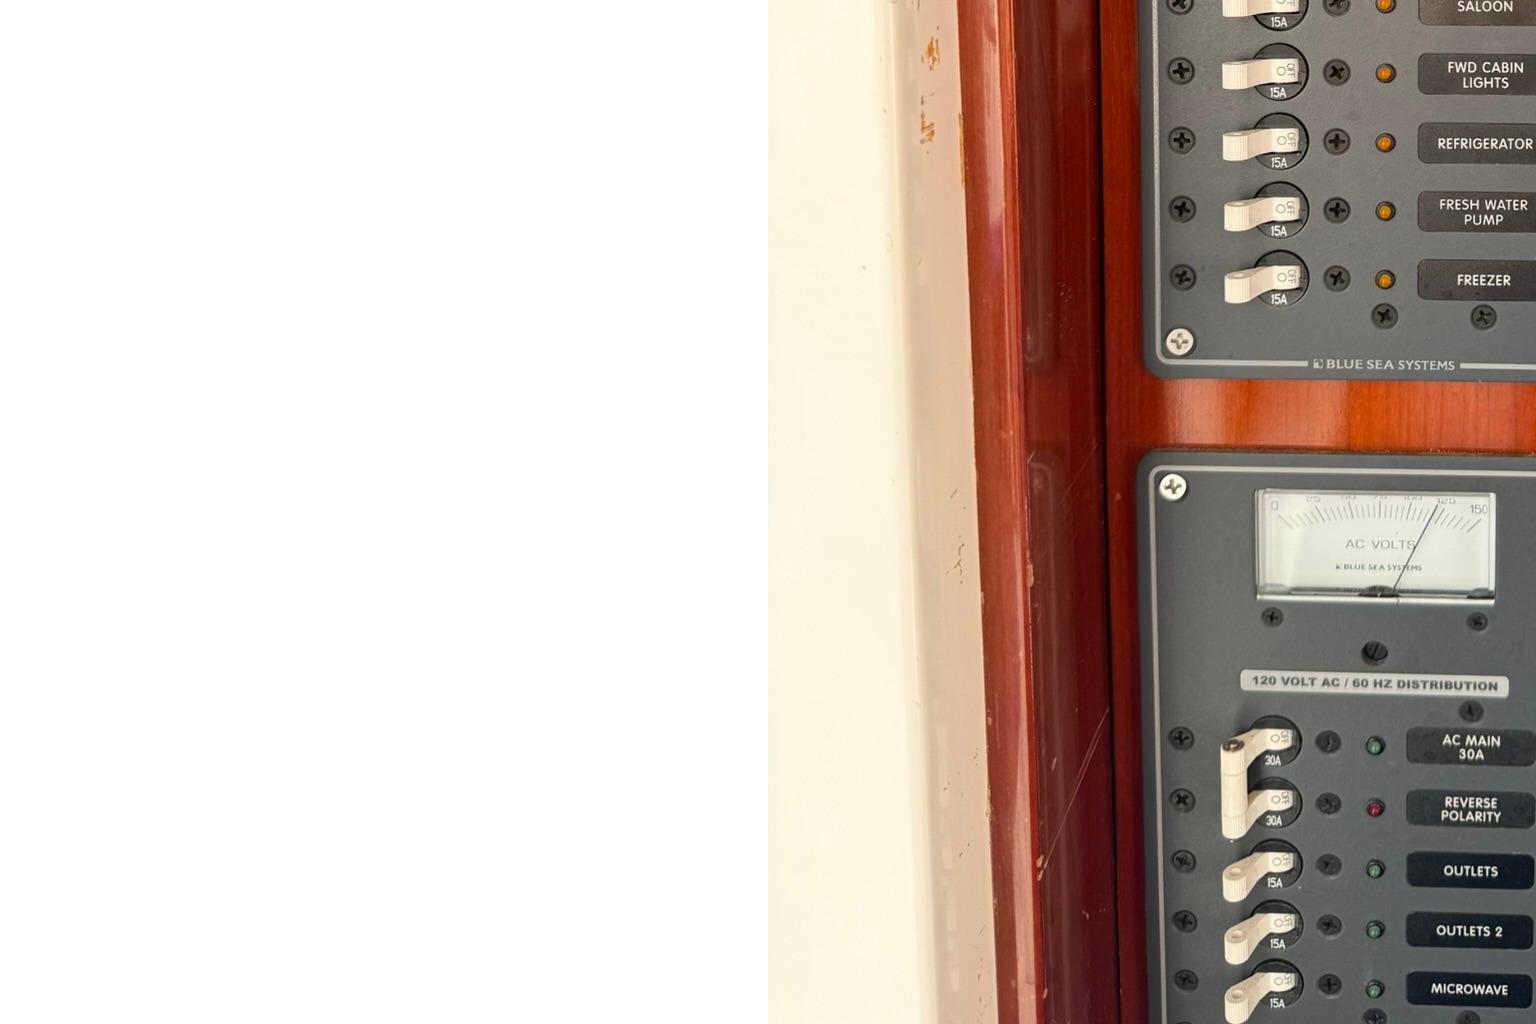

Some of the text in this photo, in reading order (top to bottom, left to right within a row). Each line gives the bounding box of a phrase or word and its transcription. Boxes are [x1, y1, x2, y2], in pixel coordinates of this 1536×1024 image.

[1457, 0, 1514, 12] SALOON
[1270, 17, 1288, 28] 15A
[1448, 62, 1524, 73] FWD CABIN
[1462, 77, 1509, 89] LIGHTS
[1270, 87, 1287, 98] 15A
[1438, 138, 1533, 150] REFRIGERATOR
[1271, 157, 1288, 169] 15A
[1440, 199, 1528, 211] FRESH WATER
[1464, 214, 1504, 226] PUMP
[1270, 226, 1288, 236] 15A
[1457, 275, 1511, 286] FREEZER
[1270, 294, 1288, 305] 15A
[1326, 359, 1455, 371] BLUE SEA SYSTEMS
[1345, 540, 1416, 549] AC VOLTS
[1253, 676, 1498, 692] 120 VOLT AC 60 HZ DISTRIBUTION
[1442, 735, 1501, 748] AC MAIN
[1459, 749, 1485, 760] 30A
[1266, 755, 1282, 767] 30A
[1444, 797, 1498, 809] REVERSE
[1266, 816, 1283, 827] 30A
[1441, 810, 1501, 823] POLARITY
[1444, 865, 1499, 877] OUTLETS
[1267, 878, 1283, 889] 15A
[1436, 925, 1503, 938] OUTLETS 2
[1270, 939, 1286, 950] 15A
[1431, 983, 1509, 996] MICROWAVE
[1270, 998, 1286, 1009] 15A
